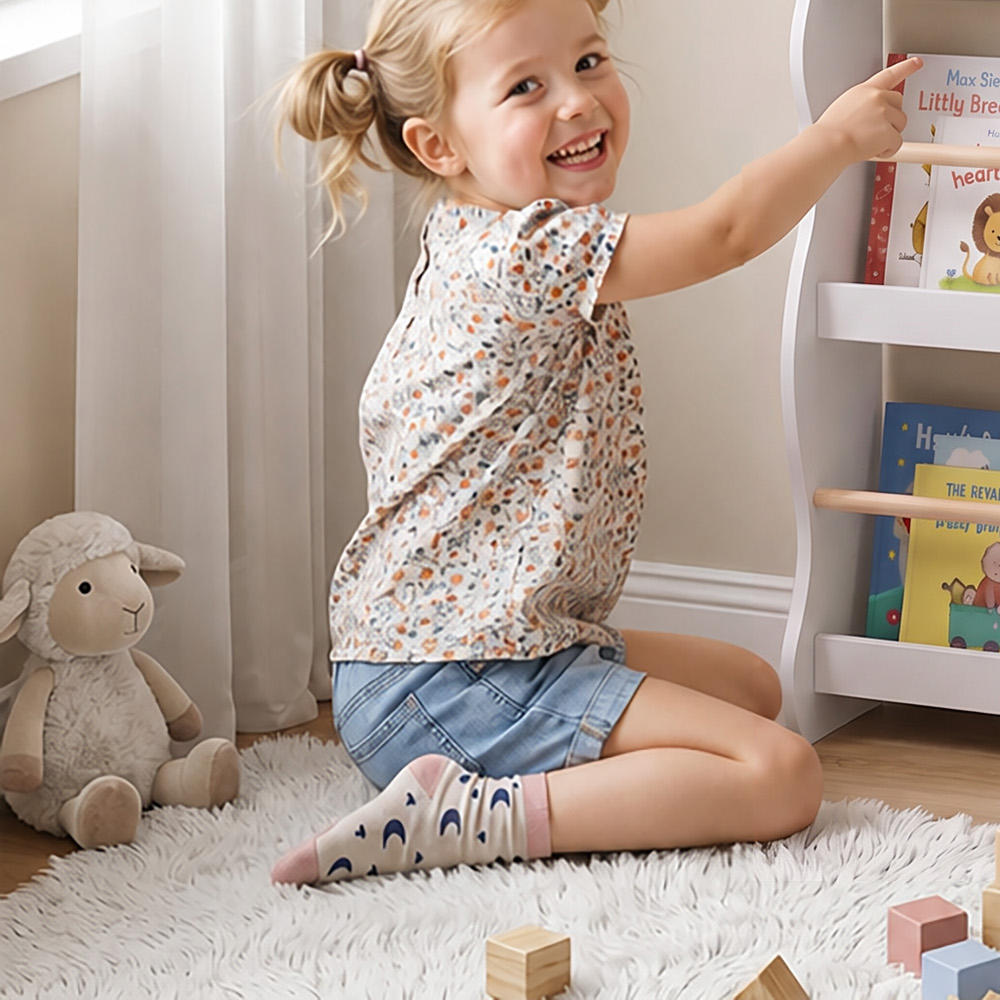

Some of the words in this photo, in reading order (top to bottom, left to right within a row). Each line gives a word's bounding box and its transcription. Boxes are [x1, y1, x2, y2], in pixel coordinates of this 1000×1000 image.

[946, 68, 977, 87] Max
[918, 90, 965, 118] Littly
[946, 482, 967, 498] THE
